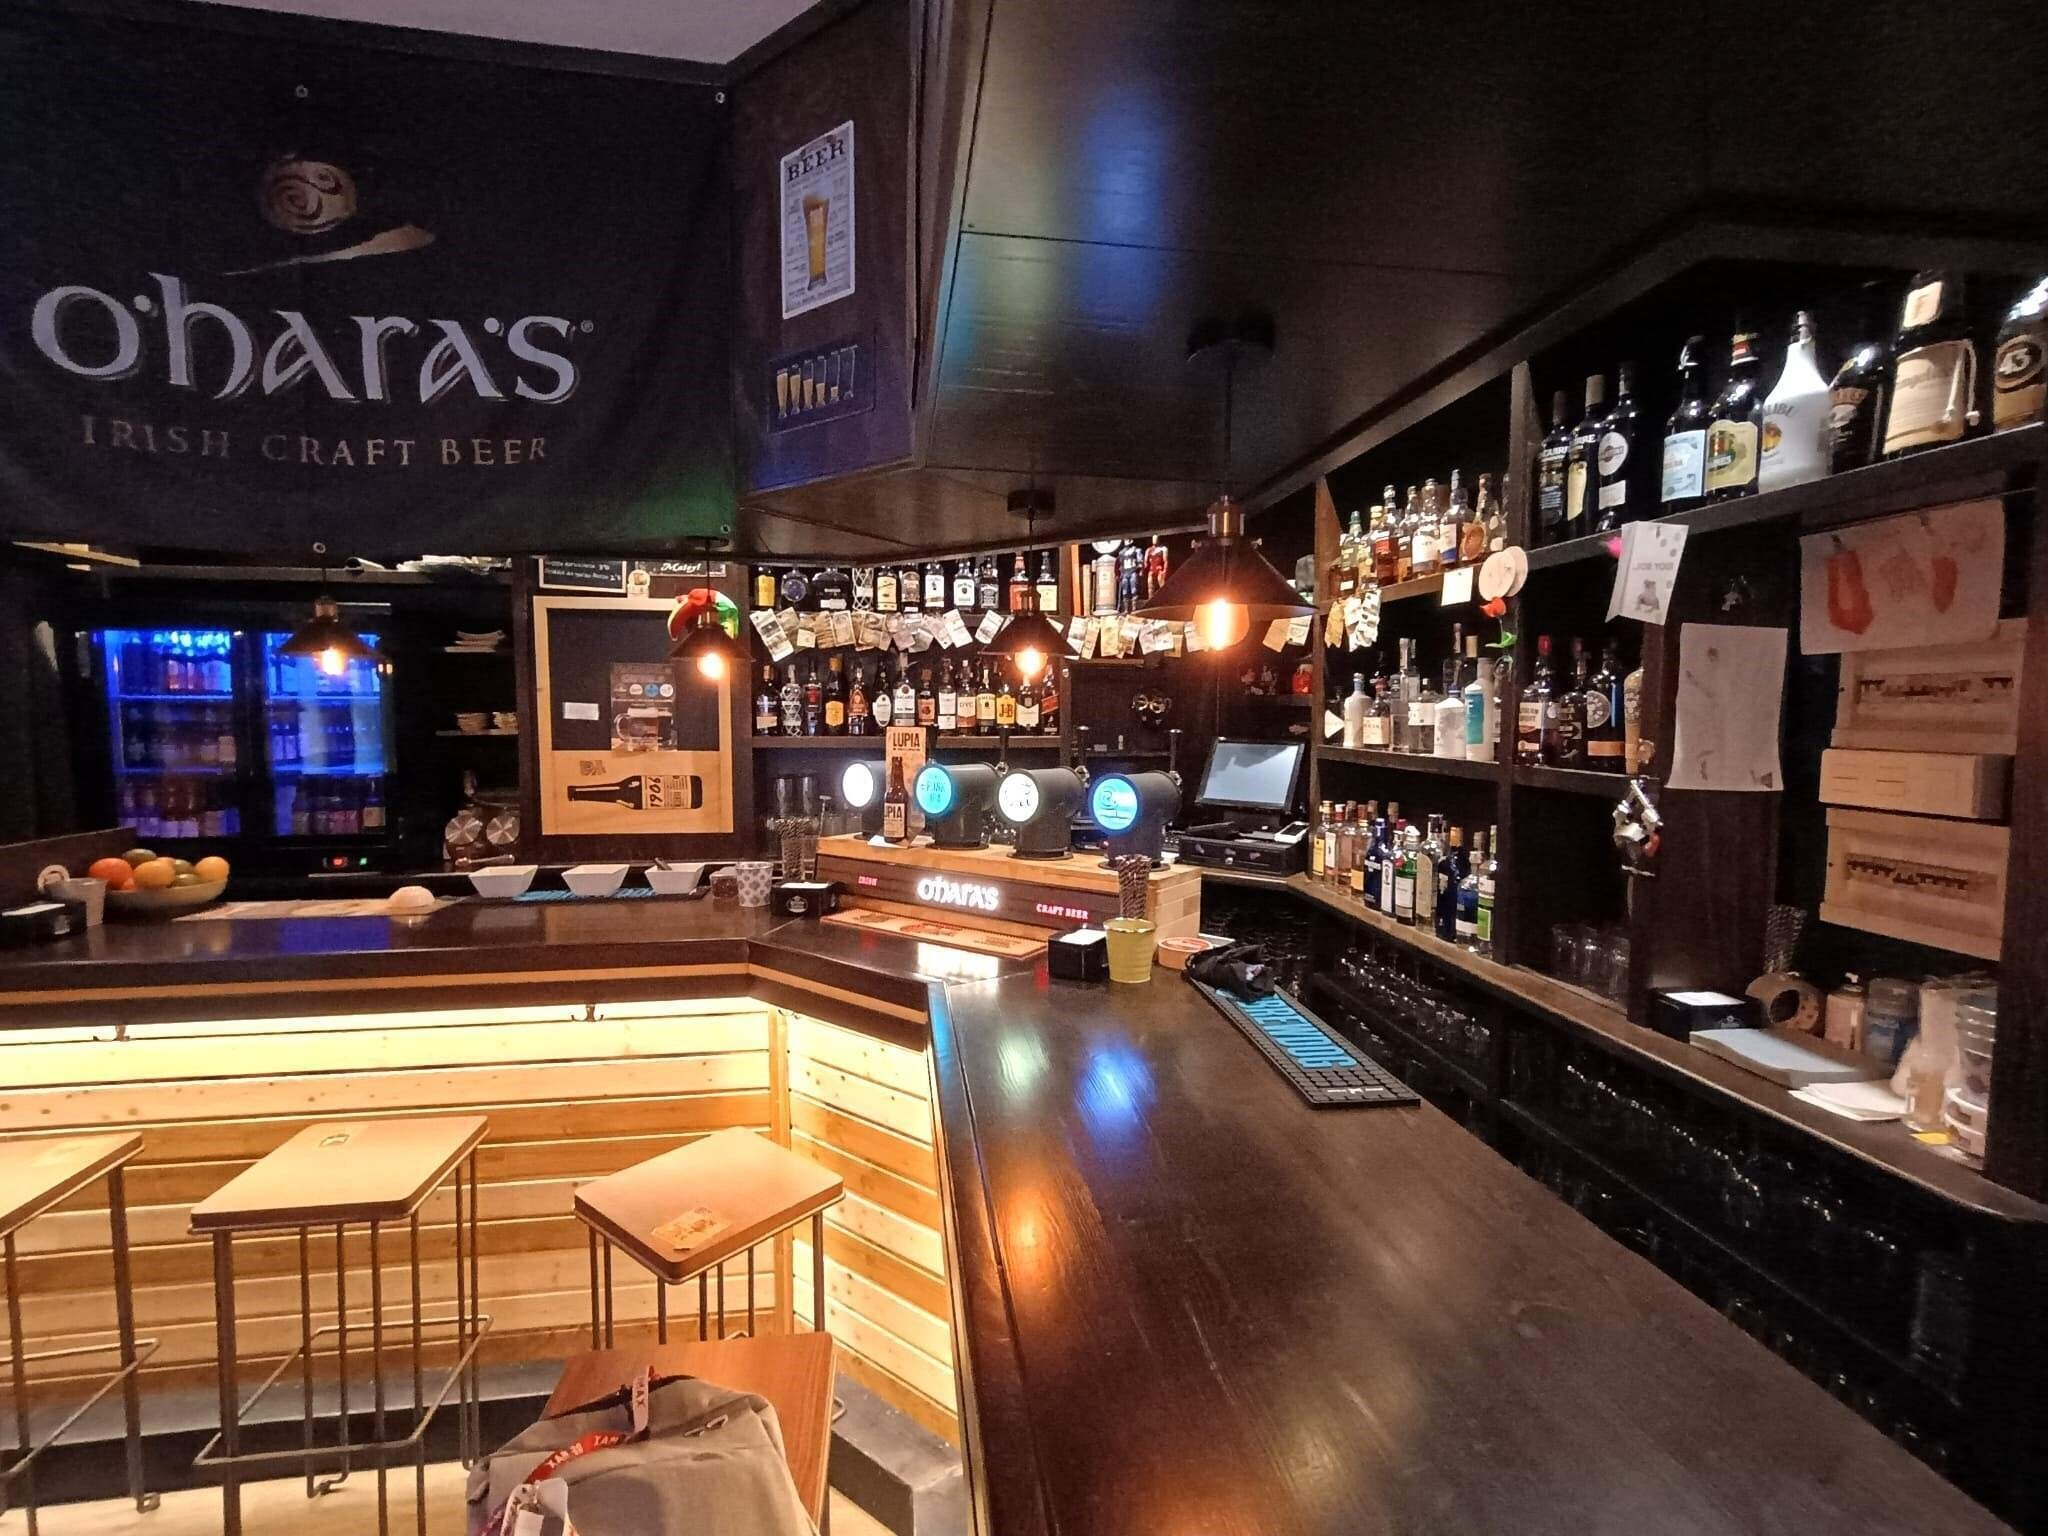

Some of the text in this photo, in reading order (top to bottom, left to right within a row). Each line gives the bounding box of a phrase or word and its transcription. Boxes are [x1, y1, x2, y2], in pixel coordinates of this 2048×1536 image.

[787, 139, 846, 184] BEER
[81, 414, 545, 466] IRISH CRAFT BEER
[892, 732, 921, 748] LUPIA
[647, 775, 664, 808] 1906
[1035, 903, 1090, 920] CRAFT BEER
